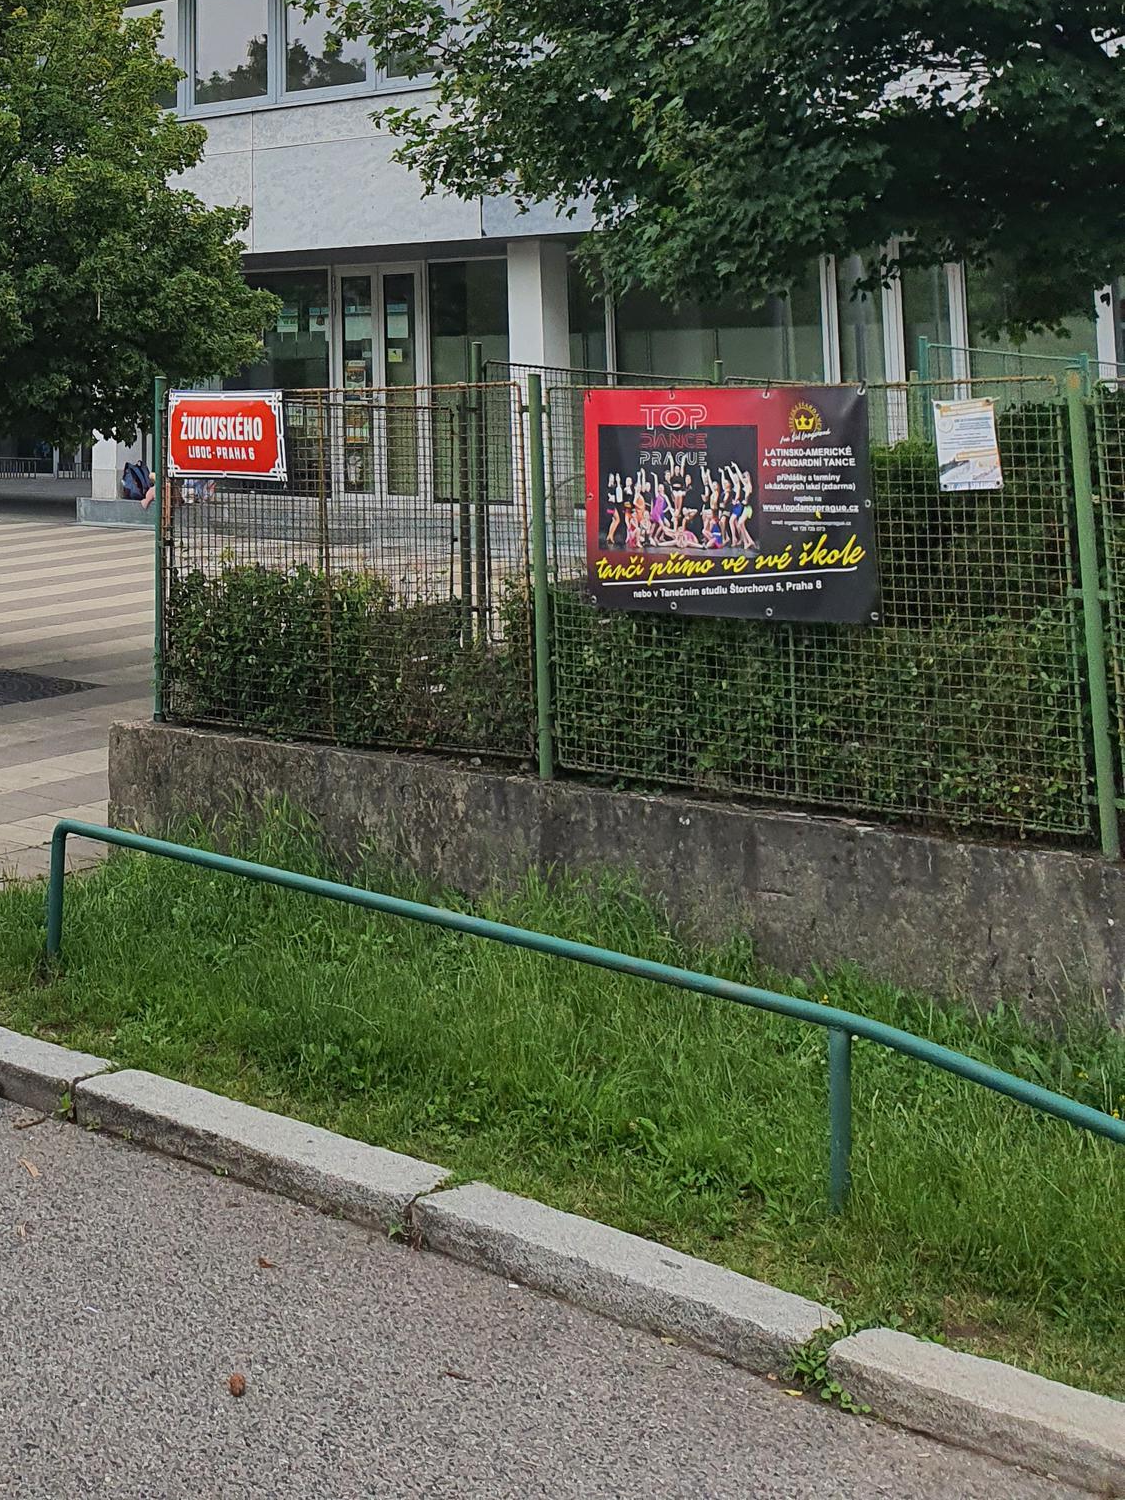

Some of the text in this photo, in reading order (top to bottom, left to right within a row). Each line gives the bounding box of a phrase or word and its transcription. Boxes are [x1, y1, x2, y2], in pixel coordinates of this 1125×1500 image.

[640, 404, 707, 430] TOP
[180, 412, 263, 441] ŽUKOVSKÉHO
[640, 432, 708, 449] DANCE
[188, 445, 212, 459] LIBOC
[216, 446, 247, 460] PRAHA
[248, 447, 255, 461] 6
[639, 451, 707, 466] PRAGUE
[765, 446, 852, 457] LATINSKO-AMERICKÉ
[763, 457, 856, 467] A STANDARDNÍ TANCE
[596, 534, 866, 586] tanči přímo ve své škole
[729, 583, 773, 594] Štorchova
[776, 582, 784, 592] 5,
[786, 581, 814, 591] Praha
[815, 580, 822, 589] 8
